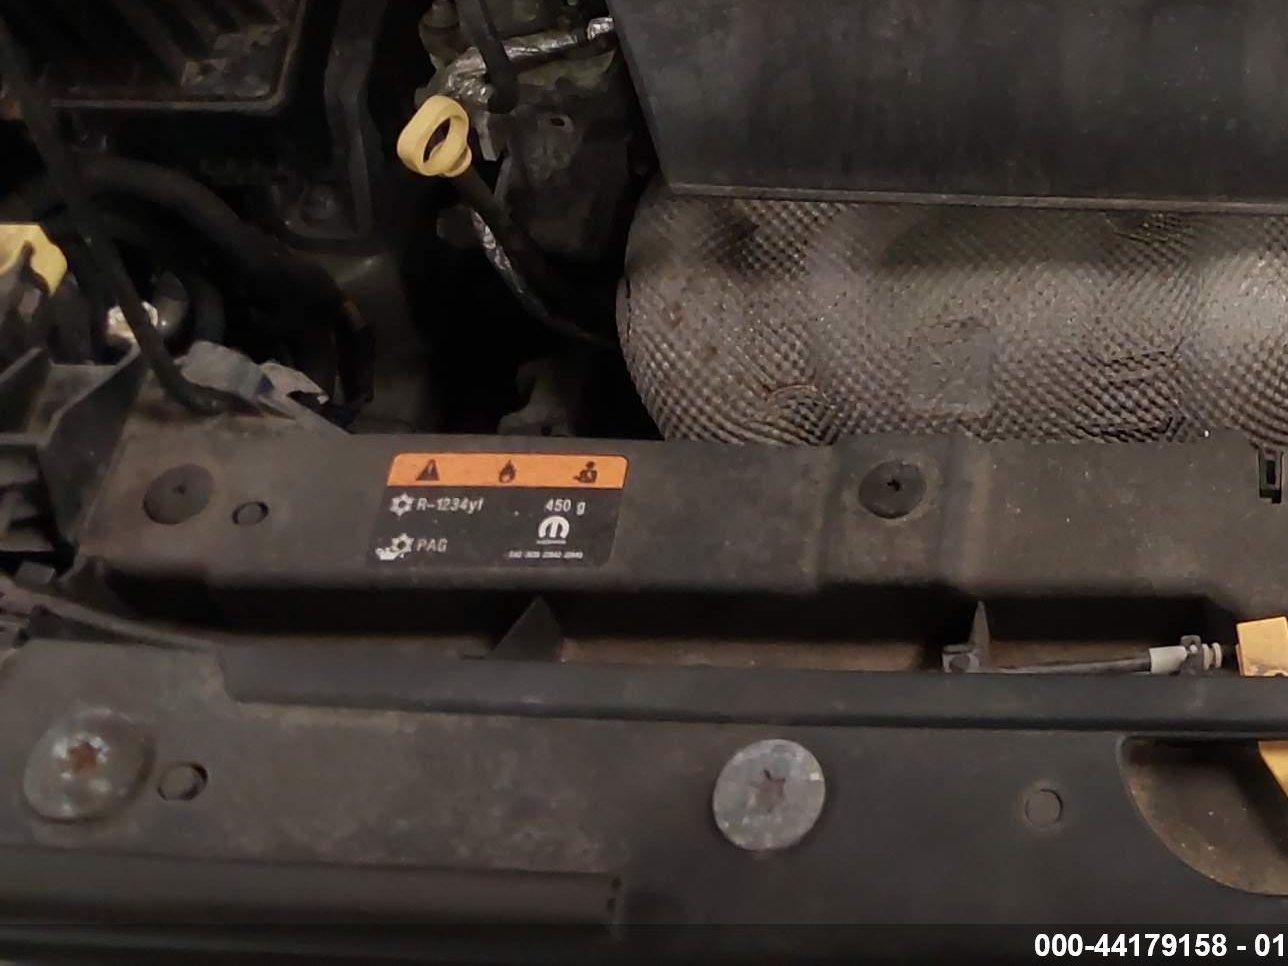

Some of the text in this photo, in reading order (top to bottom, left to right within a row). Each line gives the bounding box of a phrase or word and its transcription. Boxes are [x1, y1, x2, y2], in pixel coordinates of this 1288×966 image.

[416, 497, 485, 514] R-1234yf
[545, 498, 586, 515] 450 g
[416, 537, 449, 553] PAG
